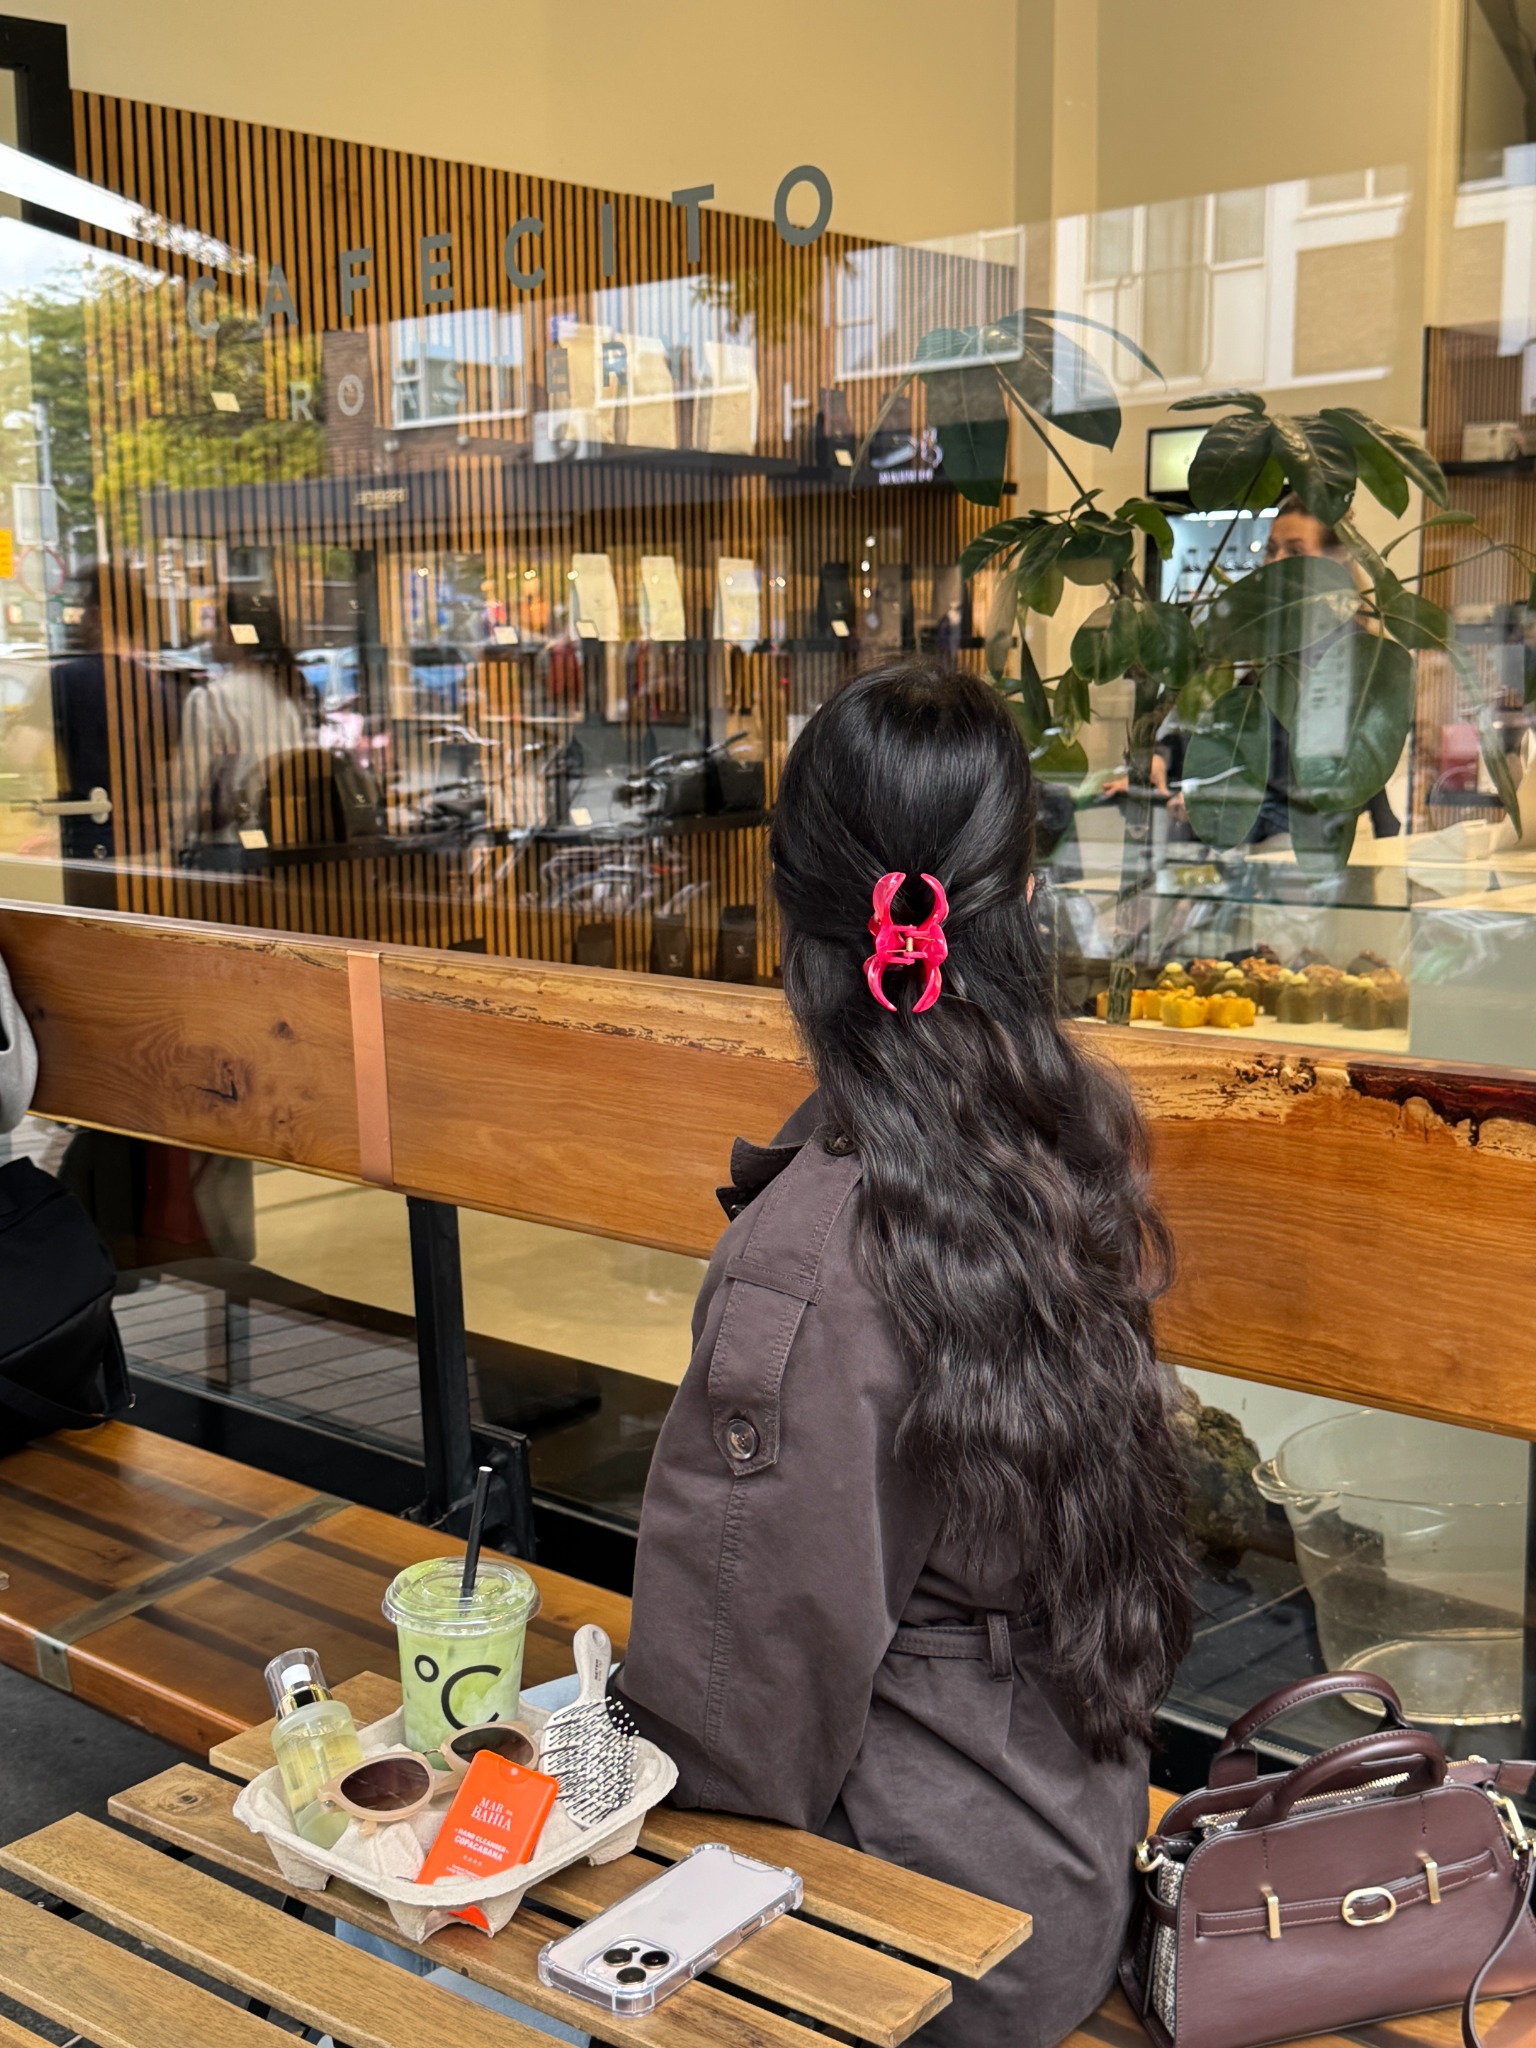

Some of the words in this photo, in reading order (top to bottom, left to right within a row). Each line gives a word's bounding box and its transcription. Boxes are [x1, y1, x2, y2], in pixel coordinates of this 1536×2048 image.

[187, 165, 833, 340] CAFECITO
[470, 1804, 512, 1832] BAHIA
[479, 1797, 504, 1812] MAR
[457, 1827, 476, 1841] HAND
[454, 1835, 503, 1862] COPACABANA
